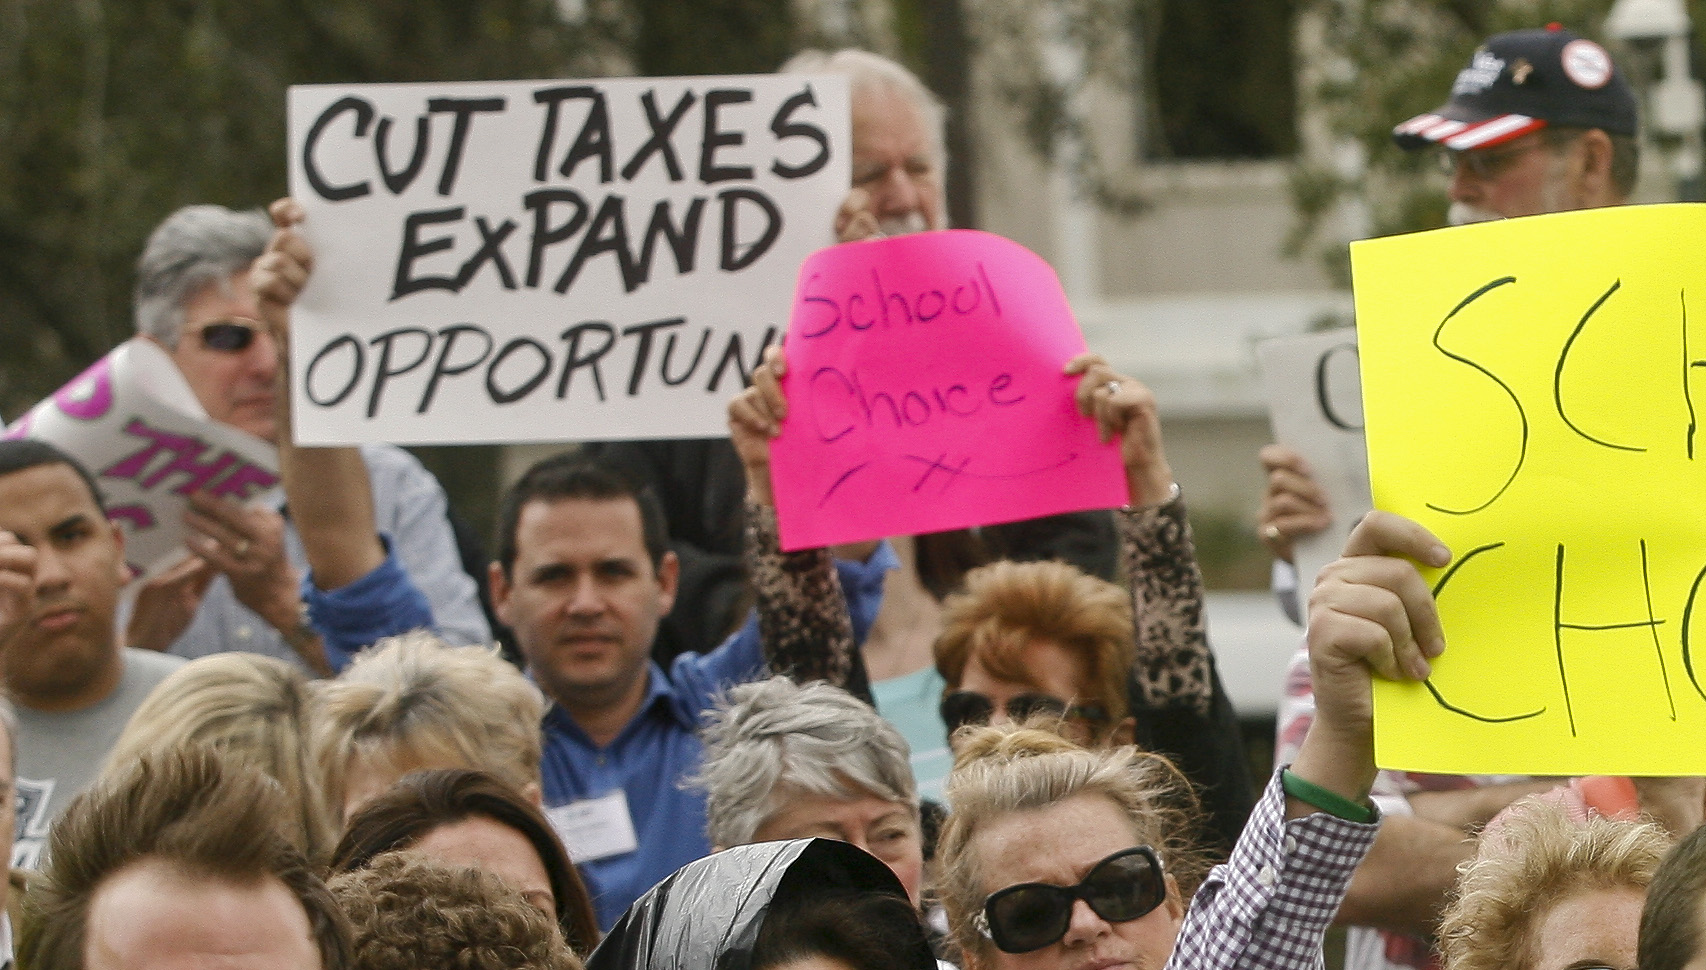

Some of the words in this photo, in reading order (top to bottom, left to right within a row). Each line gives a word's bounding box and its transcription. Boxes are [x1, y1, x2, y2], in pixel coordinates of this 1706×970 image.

[303, 96, 506, 202] CUT
[534, 83, 832, 184] TAXES
[388, 188, 784, 300] EXPAND
[802, 260, 1001, 339] School
[305, 316, 787, 420] OPPORTUN
[809, 366, 1026, 445] Choice
